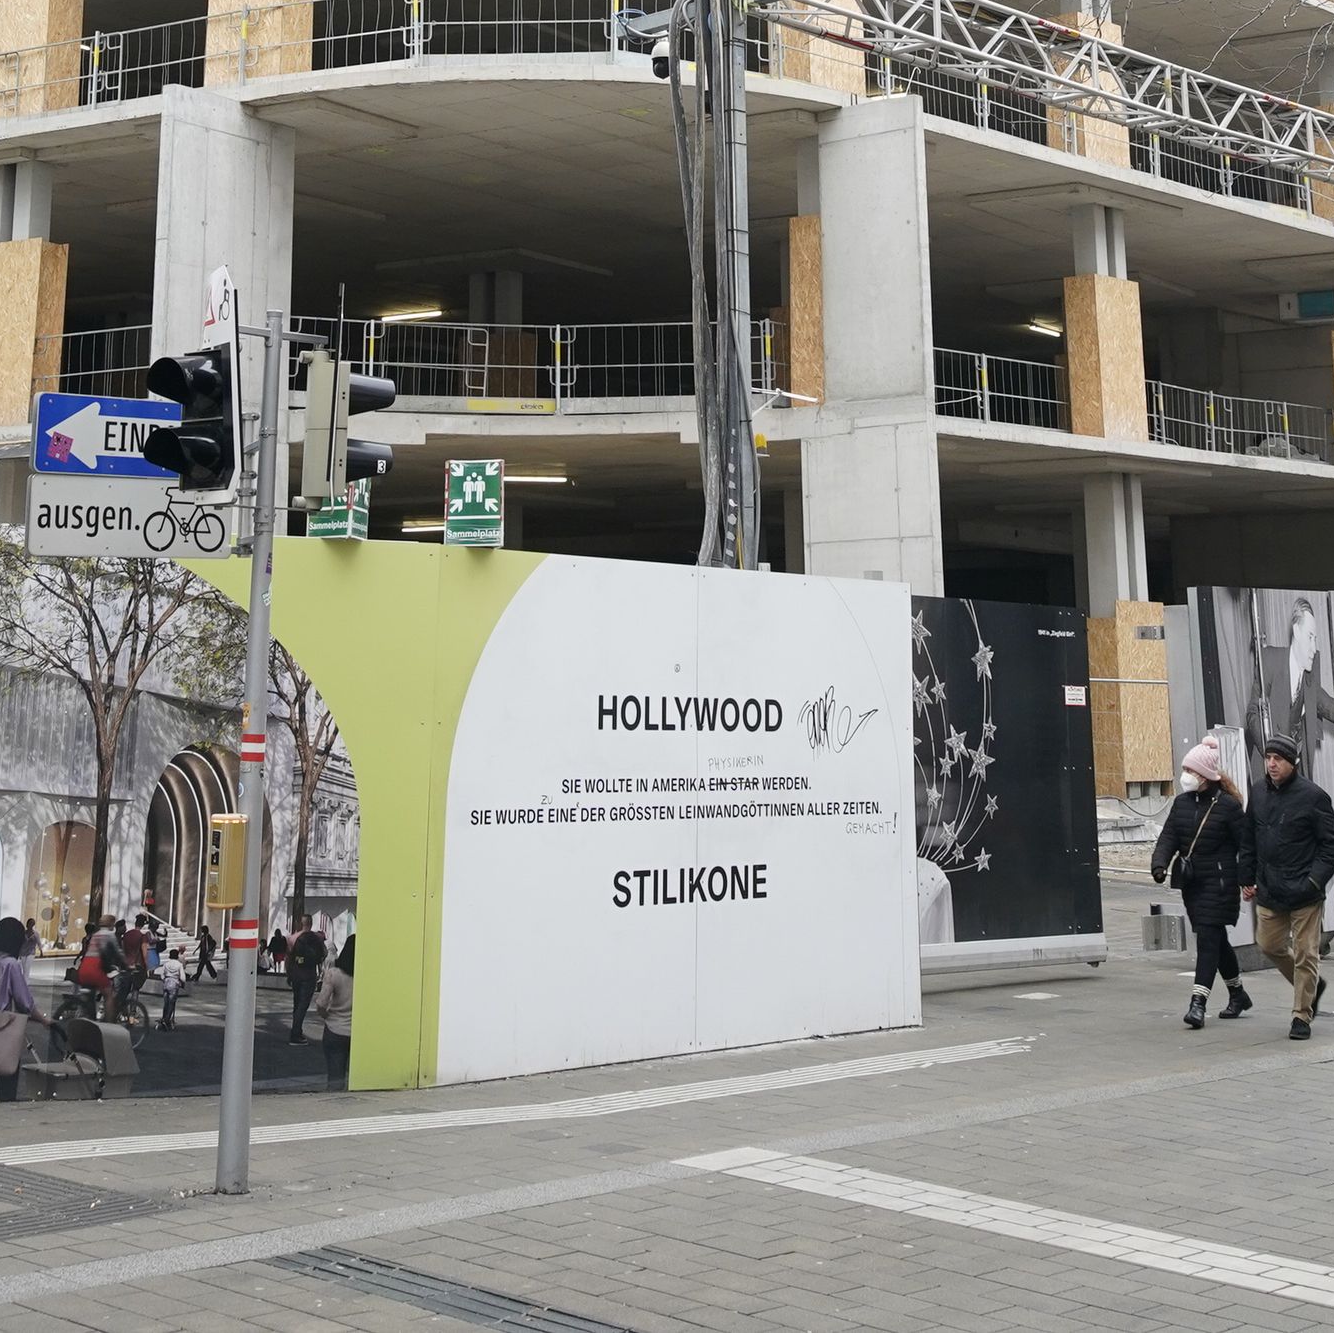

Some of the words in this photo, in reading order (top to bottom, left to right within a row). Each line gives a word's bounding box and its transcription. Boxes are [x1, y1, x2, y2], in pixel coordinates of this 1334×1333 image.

[378, 461, 386, 473] 3
[37, 503, 140, 538] ausgen.
[309, 520, 349, 532] Sammelplatz
[446, 528, 502, 540] Sammelplatz
[598, 695, 783, 732] HOLLYWOOD
[562, 779, 581, 794] SIE
[584, 779, 633, 793] WOLLTE
[636, 778, 649, 792] IN
[651, 777, 706, 792] AMERIKA
[761, 776, 812, 791] WERDEN.
[470, 809, 492, 825] SIE
[495, 809, 544, 824] WURDE
[548, 808, 577, 823] EINE
[580, 807, 605, 822] DER
[609, 802, 675, 821] GRÖSSTEN
[678, 801, 805, 819] LEINWANDGÖTTINNEN
[807, 802, 841, 817] ALLER
[843, 801, 883, 815] ZEITEN.
[613, 863, 768, 908] STILIKONE
